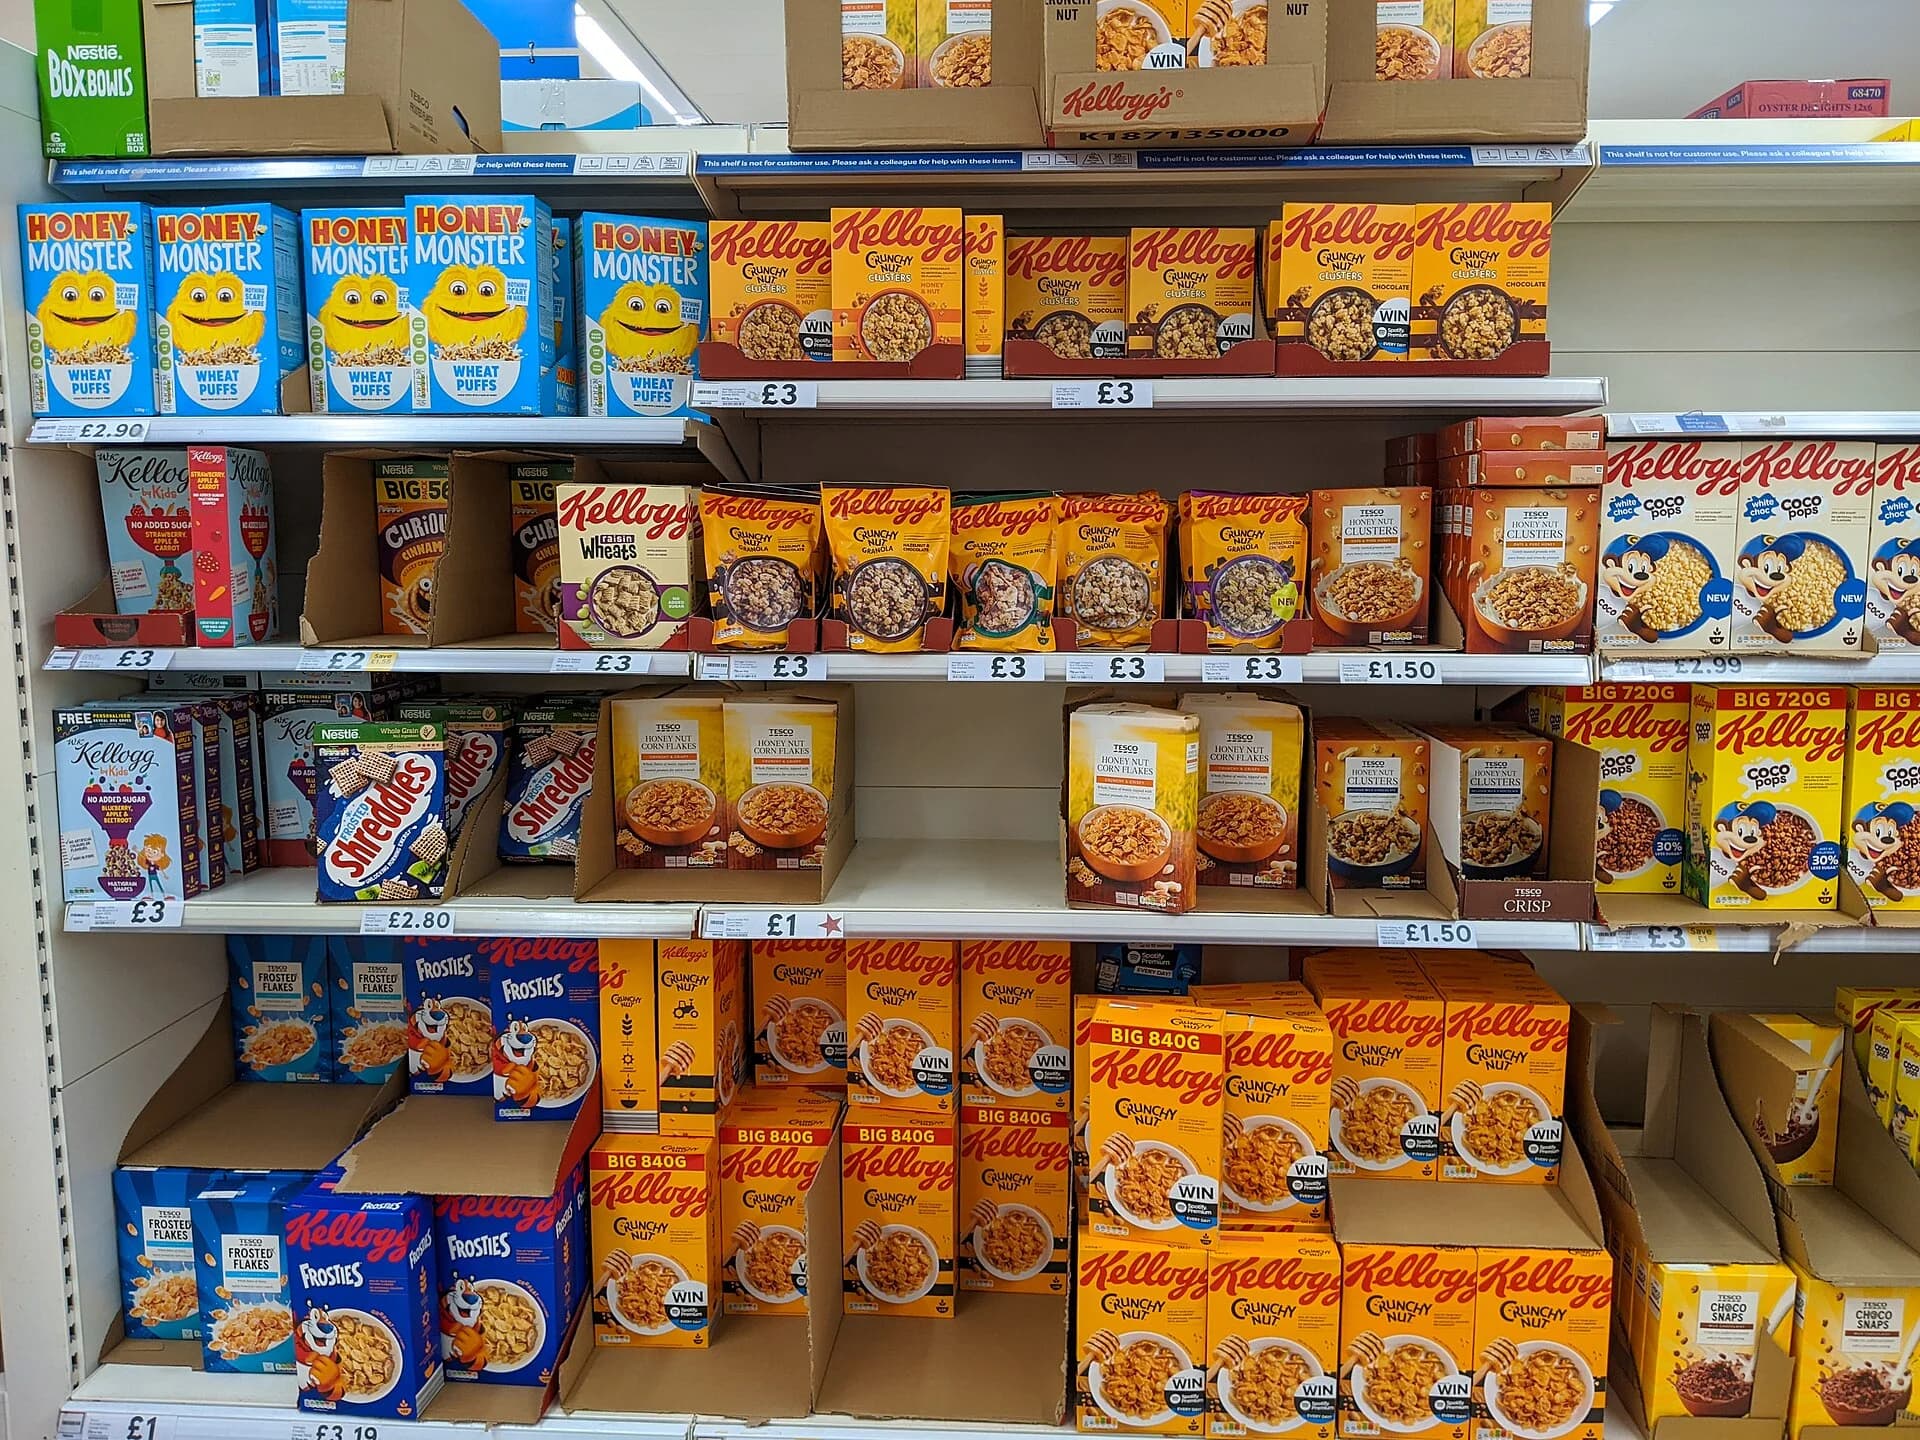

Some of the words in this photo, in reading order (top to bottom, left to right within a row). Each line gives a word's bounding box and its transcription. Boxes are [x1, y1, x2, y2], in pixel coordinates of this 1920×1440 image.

[1056, 9, 1078, 21] NUT
[1286, 2, 1308, 16] NUT
[1151, 54, 1182, 68] WIN
[1852, 87, 1881, 98] 68470
[1063, 82, 1171, 121] Kellogg's
[1758, 103, 1800, 112] OYSTER
[51, 132, 60, 143] 6
[1079, 127, 1289, 141] K187135000
[880, 158, 917, 167] colleague
[931, 158, 949, 166] help
[26, 212, 130, 241] HONEY
[413, 205, 523, 235] HONEY
[28, 241, 133, 272] MONSTER
[159, 241, 262, 272] MONSTER
[416, 234, 525, 265] MONSTER
[1450, 247, 1500, 265] CRUNCHY
[865, 251, 913, 267] CRUNCHY
[1464, 260, 1486, 269] NUT
[880, 262, 901, 273] NUT
[868, 273, 912, 283] CLUSTERS
[1163, 269, 1208, 284] CRUNCHY
[1452, 270, 1497, 280] CLUSTERS
[1177, 280, 1196, 289] NUT
[1165, 288, 1206, 299] CLUSTERS
[1222, 324, 1251, 337] WIN
[68, 369, 112, 382] WHEAT
[453, 365, 499, 379] WHEAT
[72, 382, 110, 395] PUFFS
[456, 378, 497, 392] PUFFS
[761, 384, 798, 405] £3
[1097, 382, 1134, 405] £3
[79, 424, 143, 438] £2.90
[384, 480, 421, 499] BIG
[830, 489, 945, 525] Kellogg's
[1614, 499, 1637, 507] white
[1359, 509, 1385, 518] TESCO
[1613, 507, 1633, 516] choc
[1651, 506, 1682, 521] pops
[1349, 518, 1373, 526] HONEY
[1375, 517, 1393, 525] NUT
[853, 526, 898, 542] CRUNCHY
[1344, 526, 1399, 536] CLUSTERS
[601, 535, 635, 543] raisin
[868, 537, 888, 547] NUT
[580, 536, 637, 561] Wheats
[862, 546, 894, 554] GRANOLA
[1277, 598, 1295, 607] NEW
[1706, 593, 1730, 602] NEW
[116, 651, 154, 667] £3
[328, 652, 366, 670] £2
[373, 652, 393, 660] Save
[595, 655, 631, 672] £3
[773, 656, 808, 678] £3
[991, 656, 1026, 679] £3
[1110, 657, 1145, 679] £3
[1246, 657, 1282, 679] £3
[1368, 661, 1436, 679] £1.50
[1674, 656, 1742, 674] £2.99
[1734, 692, 1771, 707] BIG
[1776, 692, 1830, 707] 720G
[58, 712, 92, 725] FREE
[380, 727, 400, 735] Whole
[402, 727, 419, 735] Grain
[645, 735, 670, 743] HONEY
[665, 742, 697, 750] FLAKES
[71, 741, 159, 774] Kellogg
[1755, 775, 1787, 791] pops
[122, 796, 146, 804] SUGAR
[330, 757, 432, 878] Shreddies
[341, 802, 369, 842] FROSTED
[1812, 855, 1839, 865] 30%
[1515, 888, 1542, 897] TESCO
[130, 900, 165, 923] £3
[1504, 899, 1551, 914] CRISP
[388, 911, 450, 930] £2.80
[767, 914, 796, 936] £1
[1406, 923, 1472, 943] £1.50
[1648, 927, 1685, 948] £3
[1690, 927, 1712, 937] Save
[415, 953, 474, 981] FROSTIES
[258, 972, 297, 983] FROSTED
[262, 982, 294, 993] FLAKES
[1111, 1027, 1143, 1045] BIG
[1149, 1030, 1200, 1050] 840G
[1115, 1097, 1178, 1121] CRUNCHY
[1135, 1115, 1161, 1127] NUT
[607, 1154, 637, 1169] BIG
[639, 1155, 687, 1170] 840G
[1178, 1184, 1214, 1200] WIN
[239, 1238, 263, 1246] TESCO
[228, 1247, 273, 1259] FROSTED
[233, 1259, 269, 1270] FLAKES
[299, 1261, 364, 1289] FROSTIES
[1366, 1294, 1432, 1317] CRUNCHY
[1718, 1294, 1742, 1303] TESCO
[1710, 1302, 1747, 1313] CHOCO
[1387, 1311, 1416, 1324] NUT
[1711, 1312, 1743, 1323] SNAPS
[1438, 1383, 1468, 1395] WIN
[127, 1416, 157, 1440] £1
[316, 1425, 378, 1440] £3.19
